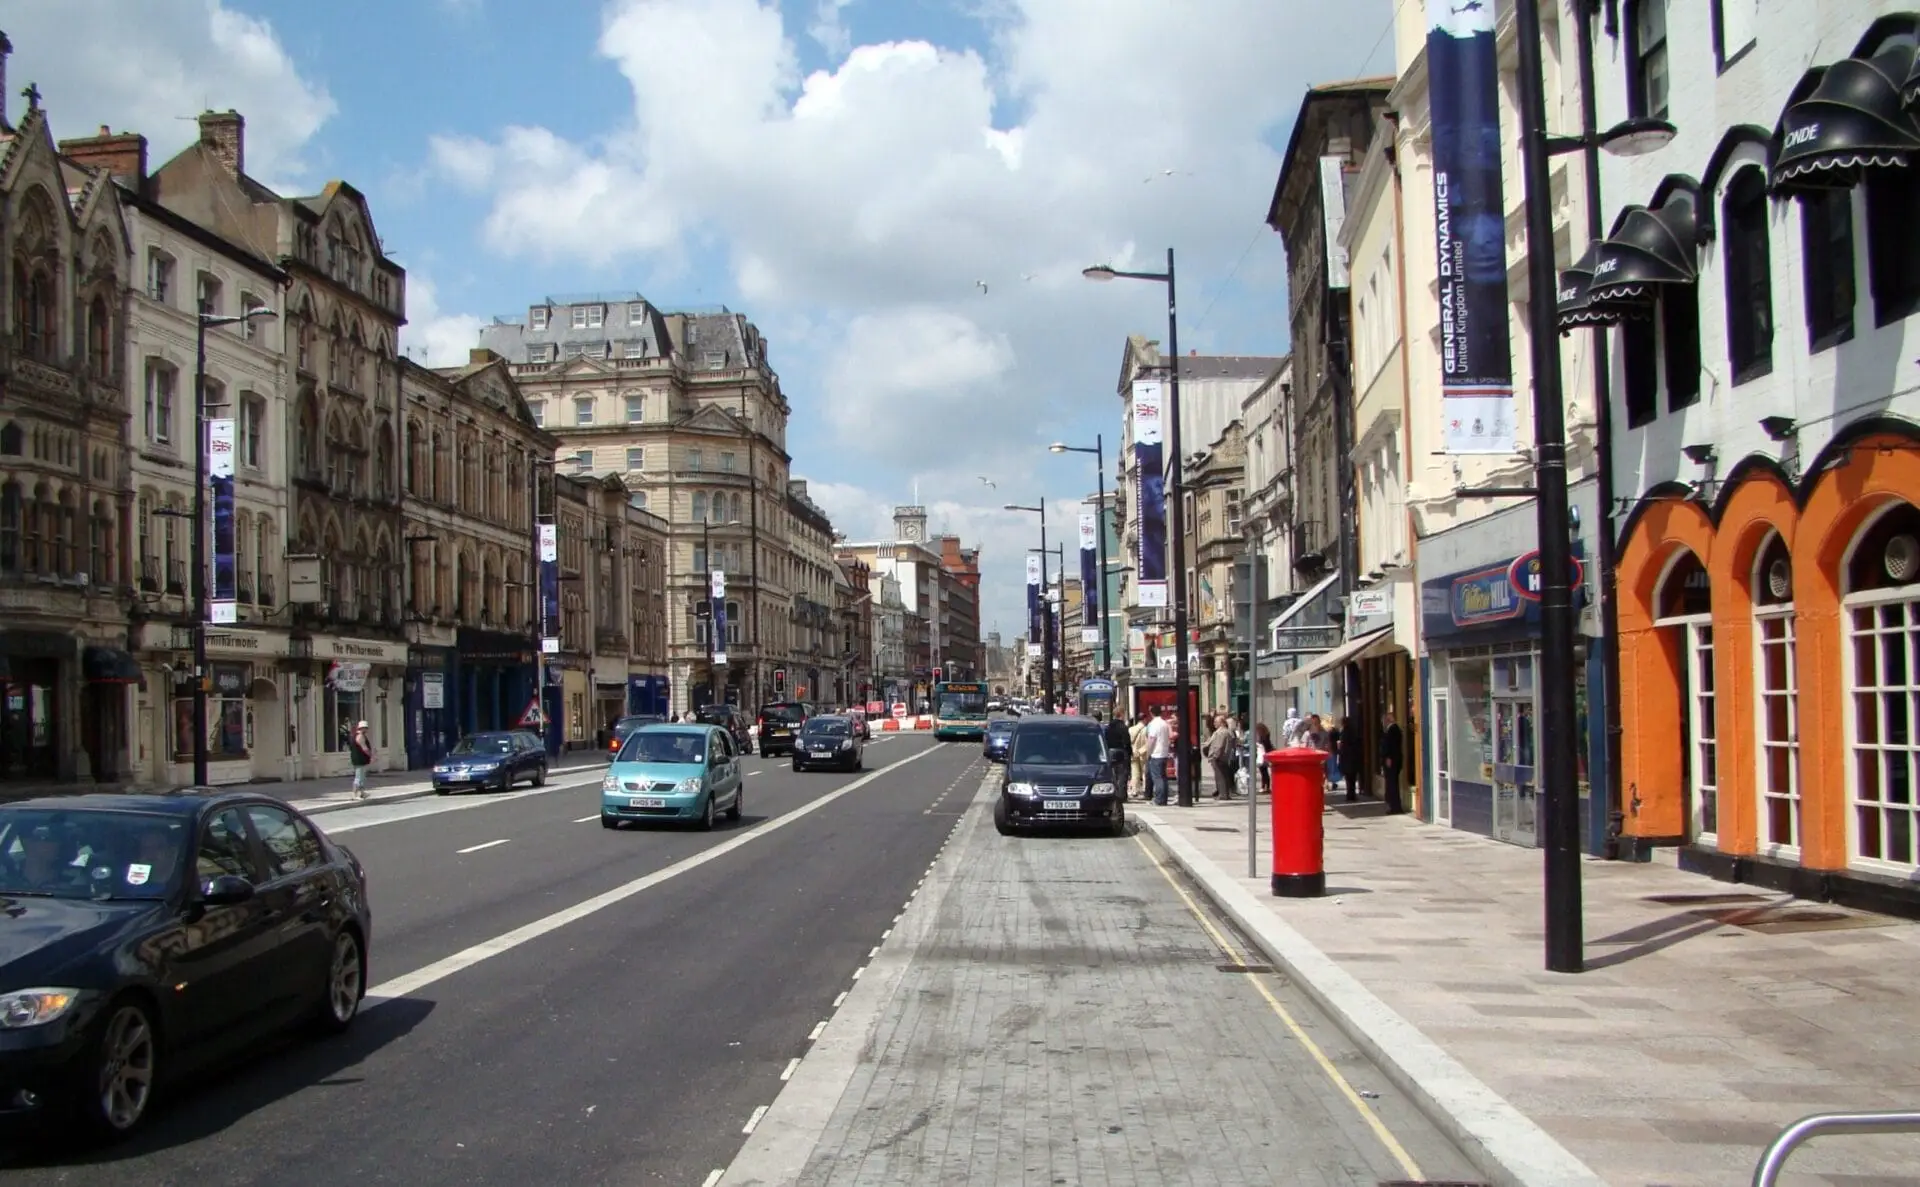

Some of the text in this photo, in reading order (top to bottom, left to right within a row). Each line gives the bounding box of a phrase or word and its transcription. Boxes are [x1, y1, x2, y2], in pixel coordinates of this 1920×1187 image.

[1436, 171, 1456, 374] GENERAL DYNAMICS
[1453, 240, 1469, 374] United Kingdom Limited
[1490, 580, 1511, 609] HILL
[332, 642, 384, 656] The Philharmonic
